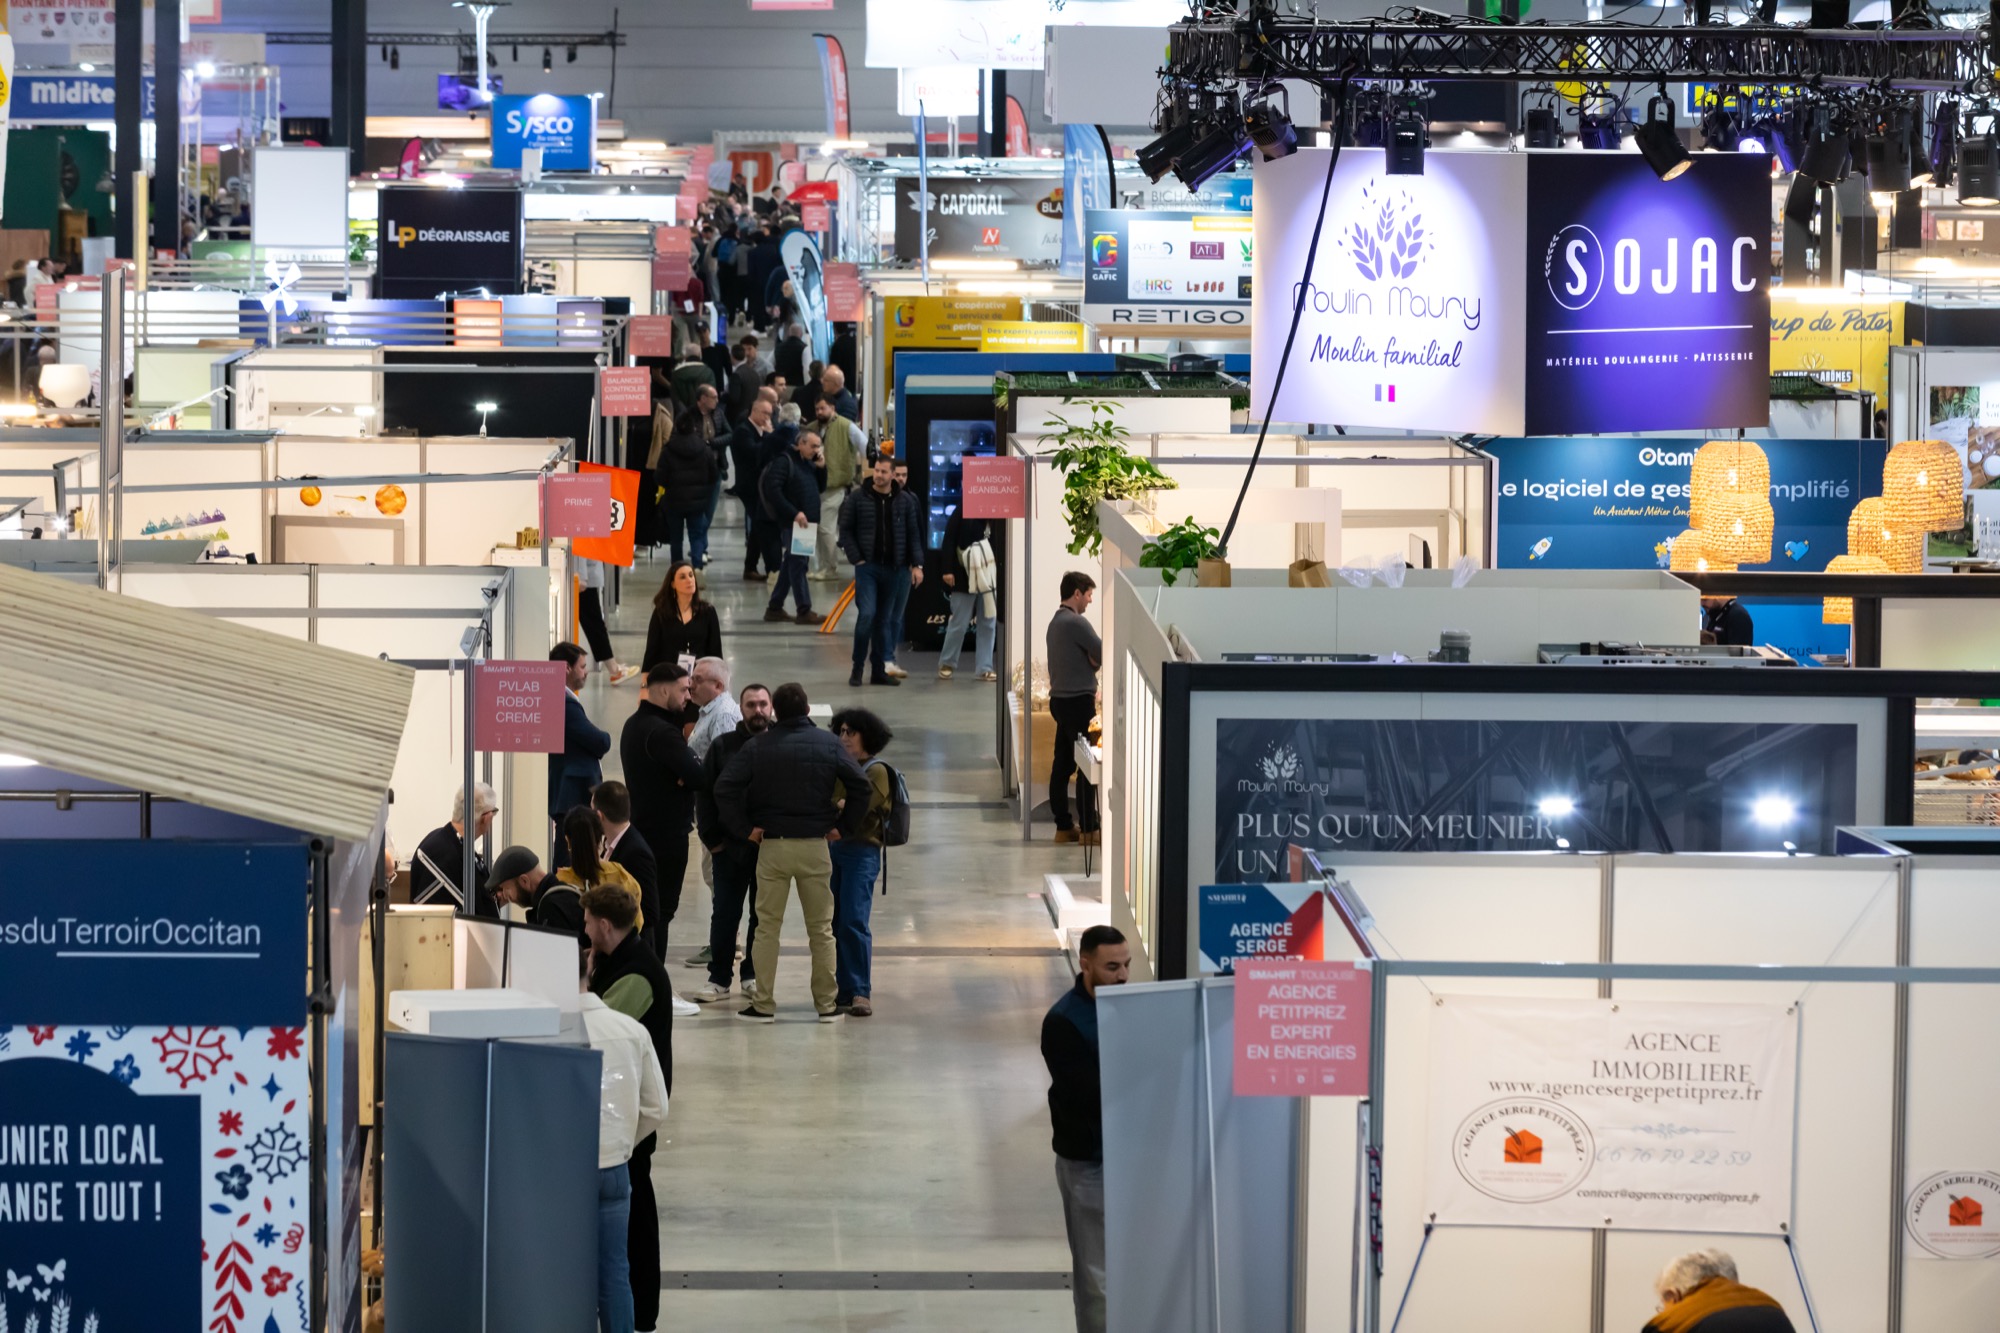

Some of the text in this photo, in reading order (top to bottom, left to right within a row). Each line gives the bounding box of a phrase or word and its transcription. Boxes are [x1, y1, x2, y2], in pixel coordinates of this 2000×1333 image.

[506, 110, 574, 139] Sysco
[939, 193, 1005, 216] CAPORAL
[1152, 191, 1212, 203] BICHARD
[388, 220, 510, 248] LP DÉGRAISSAGE
[1565, 236, 1757, 296] SOJAC
[1145, 279, 1172, 290] HRC
[955, 300, 1007, 310] coopérative
[1293, 282, 1481, 331] Moulin Maury
[1112, 309, 1245, 324] RETIGO
[1809, 310, 1836, 331] de
[1004, 328, 1031, 336] experts
[1034, 328, 1077, 336] passionnés
[1310, 333, 1463, 368] Moulin familial
[1546, 356, 1599, 367] MATÉRIEL
[1604, 354, 1679, 365] BOULANGERIE
[1693, 351, 1754, 362] PÂTISSERIE
[1820, 369, 1852, 382] ARÔMES
[968, 486, 1019, 494] JEANBLANC
[1498, 483, 1517, 497] e
[1524, 479, 1606, 501] logiciel
[1613, 479, 1646, 498] de
[1651, 484, 1692, 501] ges
[564, 498, 592, 506] PRIME
[1593, 506, 1607, 516] Un
[1607, 506, 1643, 516] Assistant
[1644, 506, 1671, 517] Métier
[499, 681, 540, 692] PVLAB
[496, 696, 541, 708] ROBOT
[496, 712, 541, 723] CREME
[1237, 779, 1329, 797] Moulin Maury
[1237, 813, 1310, 838] PLUS
[1317, 813, 1414, 843] QU'UN
[1237, 850, 1278, 874] UN
[1230, 922, 1293, 937] AGENCE
[1236, 939, 1288, 953] SERGE
[1300, 970, 1356, 981] TOULOUSE
[1268, 985, 1337, 1000] AGENCE
[1258, 1005, 1346, 1020] PETITPREZ
[1270, 1025, 1333, 1039] EXPERT
[1624, 1033, 1721, 1053] AGENCE
[1247, 1045, 1356, 1060] EN ENERGIES
[1592, 1060, 1751, 1082] IMMOBILIERE
[1489, 1080, 1763, 1104] www.agencesergepetitprez.fr
[1463, 1106, 1585, 1154] AGENCE SERGE PETITPREZ
[80, 1124, 163, 1165] LOCAL
[1690, 1149, 1719, 1165] 22
[1725, 1151, 1751, 1165] 59
[0, 1181, 162, 1223] ANGE TOUT !
[1577, 1189, 1760, 1205] contact@agencesergepetitprez.fr
[1914, 1183, 1942, 1216] AGENCE
[1943, 1176, 1976, 1186] SERGE
